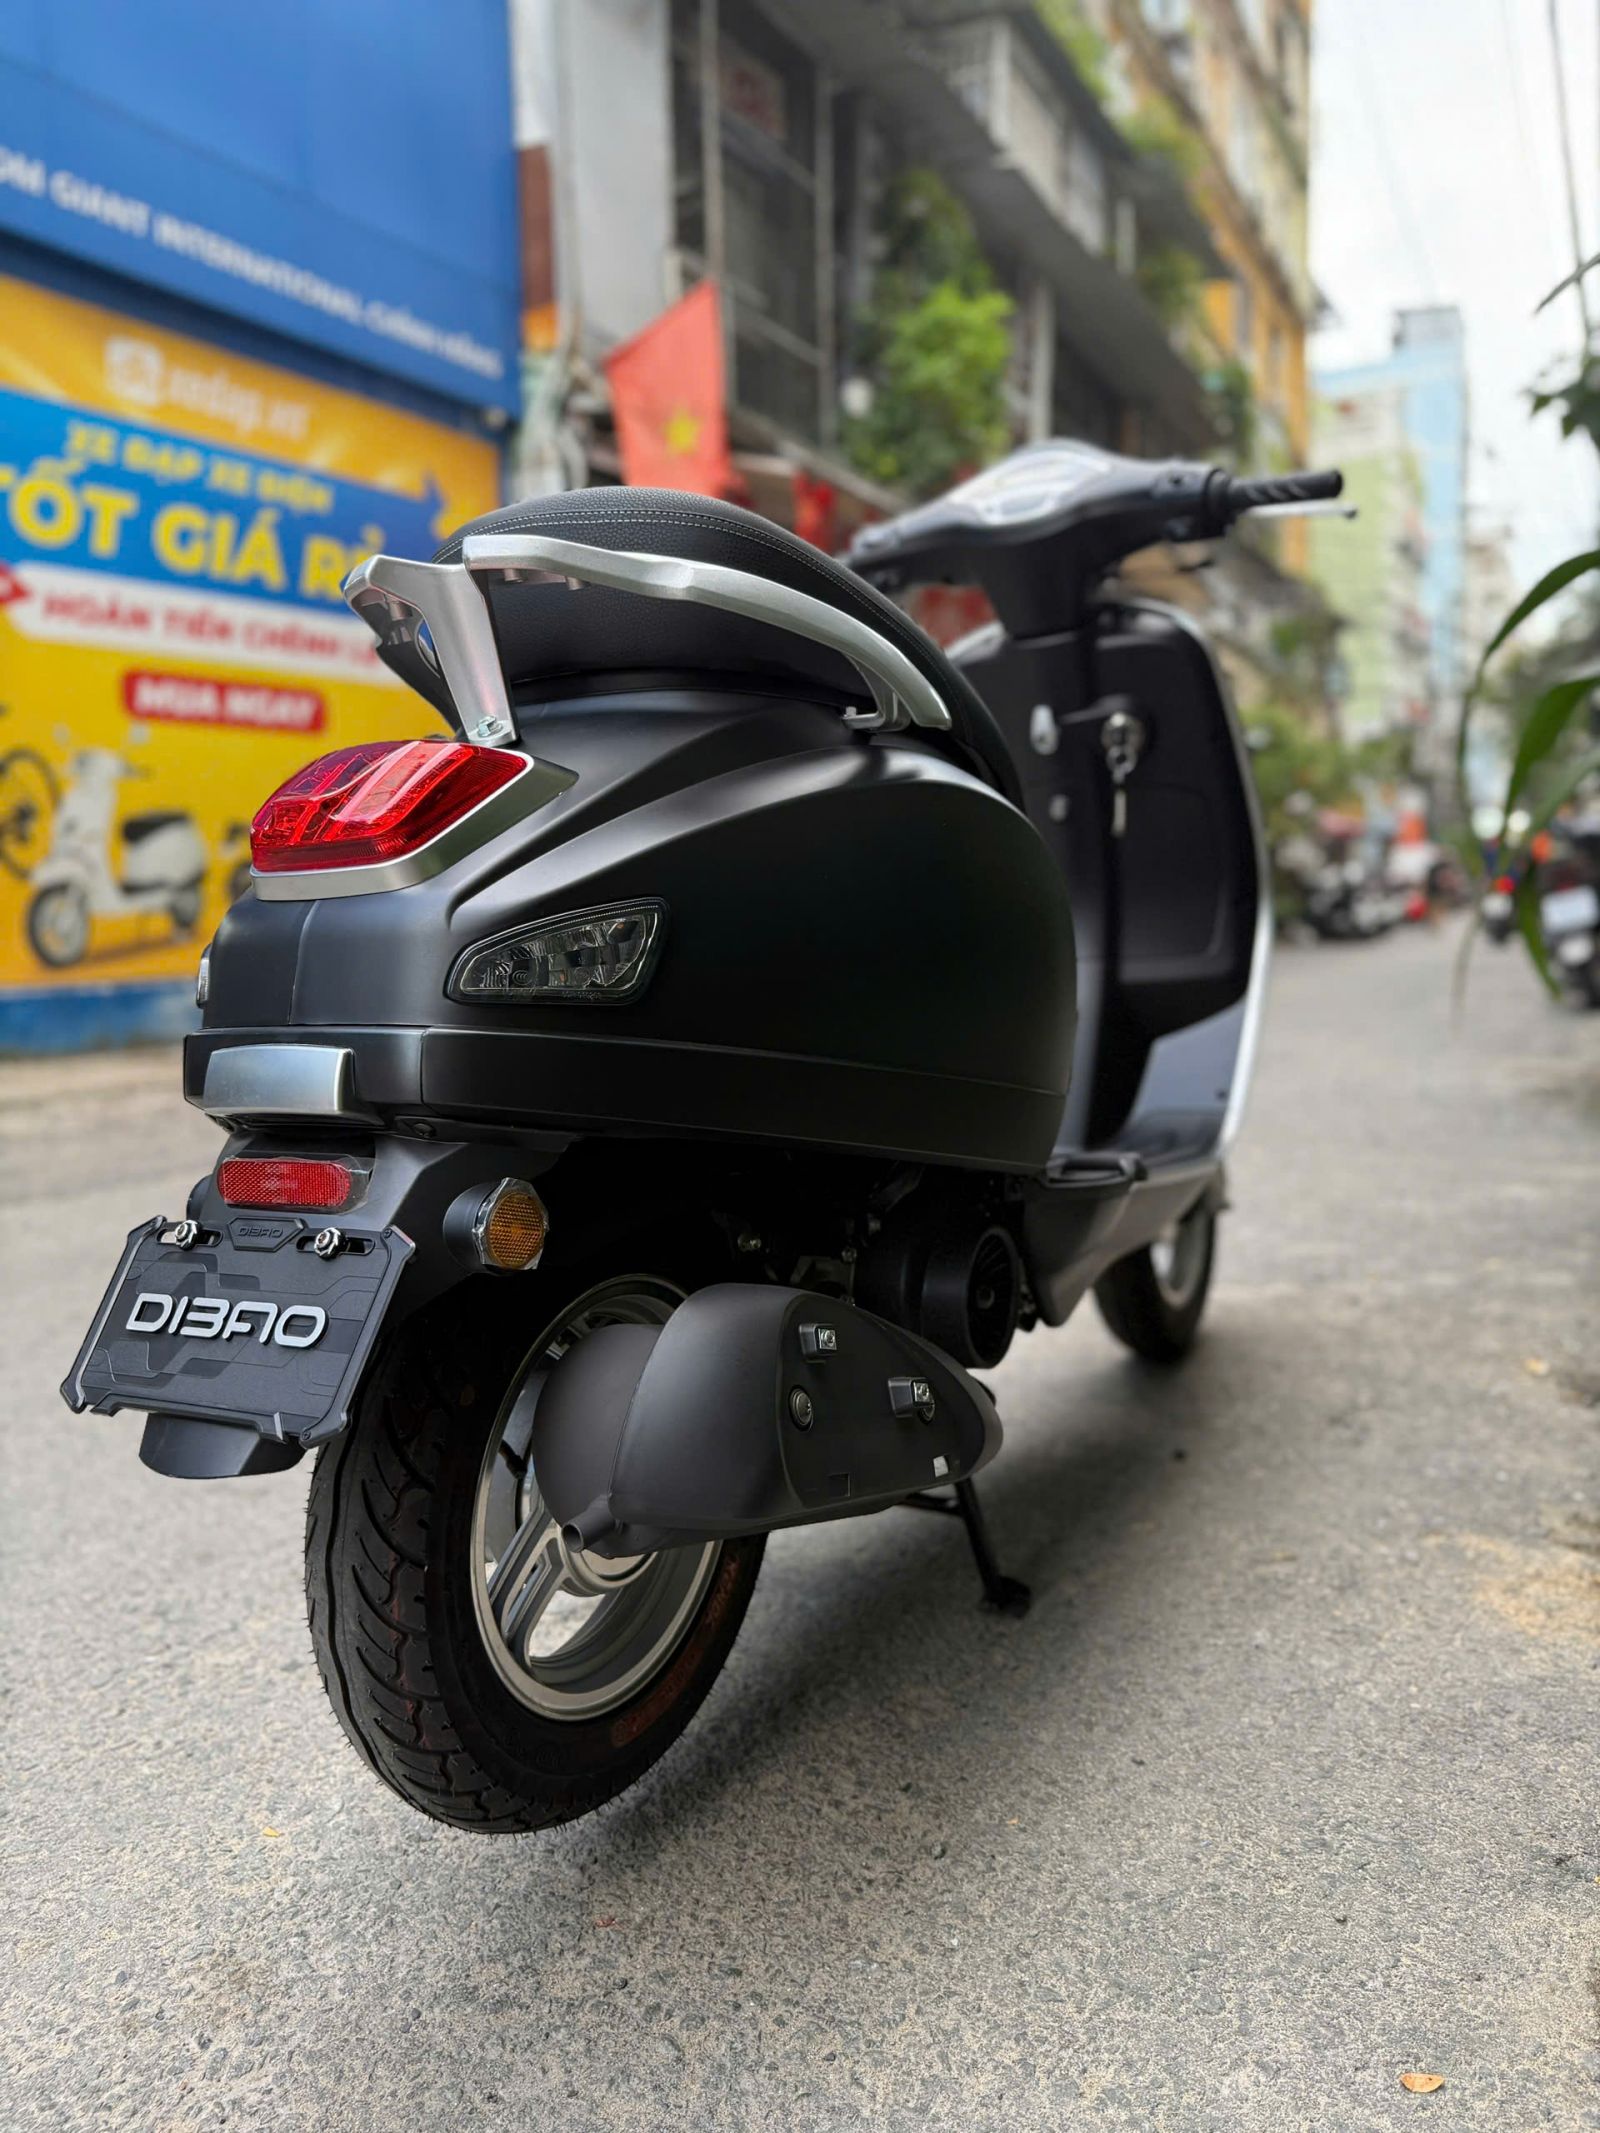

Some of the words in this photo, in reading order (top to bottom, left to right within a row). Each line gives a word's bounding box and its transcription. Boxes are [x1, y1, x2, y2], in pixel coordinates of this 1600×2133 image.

[69, 422, 117, 463] XE
[153, 507, 286, 590] GIÁ
[133, 676, 219, 718] MUA
[223, 684, 317, 727] NGAY
